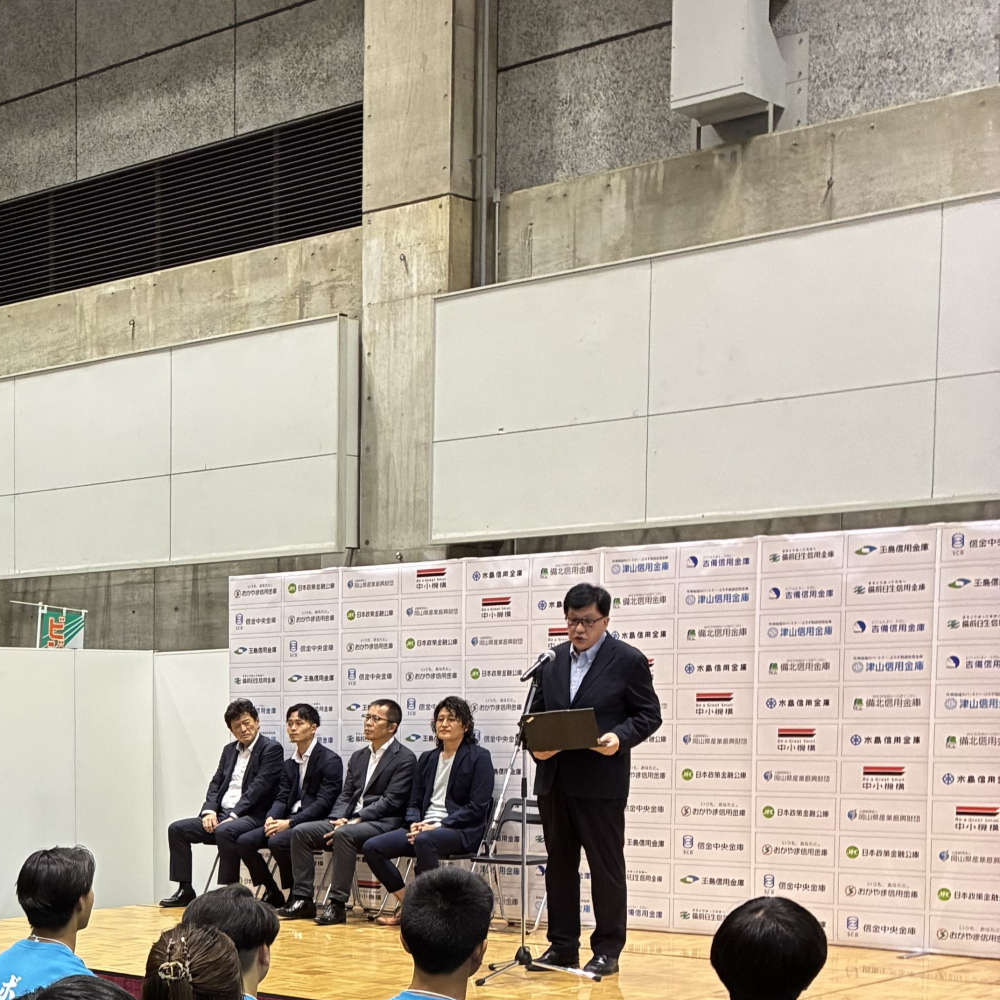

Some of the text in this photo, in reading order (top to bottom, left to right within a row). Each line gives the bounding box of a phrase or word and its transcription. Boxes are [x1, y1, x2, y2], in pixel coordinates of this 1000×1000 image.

[703, 558, 750, 567] 吉備信用金庫
[622, 562, 669, 573] 津山信用金庫
[698, 593, 749, 604] 津山信用金庫
[785, 589, 833, 599] 吉備信用金庫
[780, 626, 832, 637] 津山信用金庫
[872, 623, 925, 633] 吉備信用金庫
[697, 664, 747, 672] 水島信用金庫
[866, 661, 923, 672] 津山信用金庫
[779, 699, 830, 707] 水島信用金庫
[864, 736, 921, 744] 水島信用金庫
[695, 771, 746, 779] 日本政策金融公庫
[862, 782, 904, 790] 中小機構
[692, 808, 745, 816] おかやま信用金庫
[777, 809, 829, 818] 日本政策金融公庫
[955, 823, 999, 832] 中小機構
[698, 842, 744, 851] 信金中央金庫
[774, 846, 828, 856] おかやま信用金庫
[862, 849, 919, 859] 日本政策金融公庫
[858, 889, 918, 898] おかやま信用金庫
[863, 924, 916, 935] 信金中央金庫
